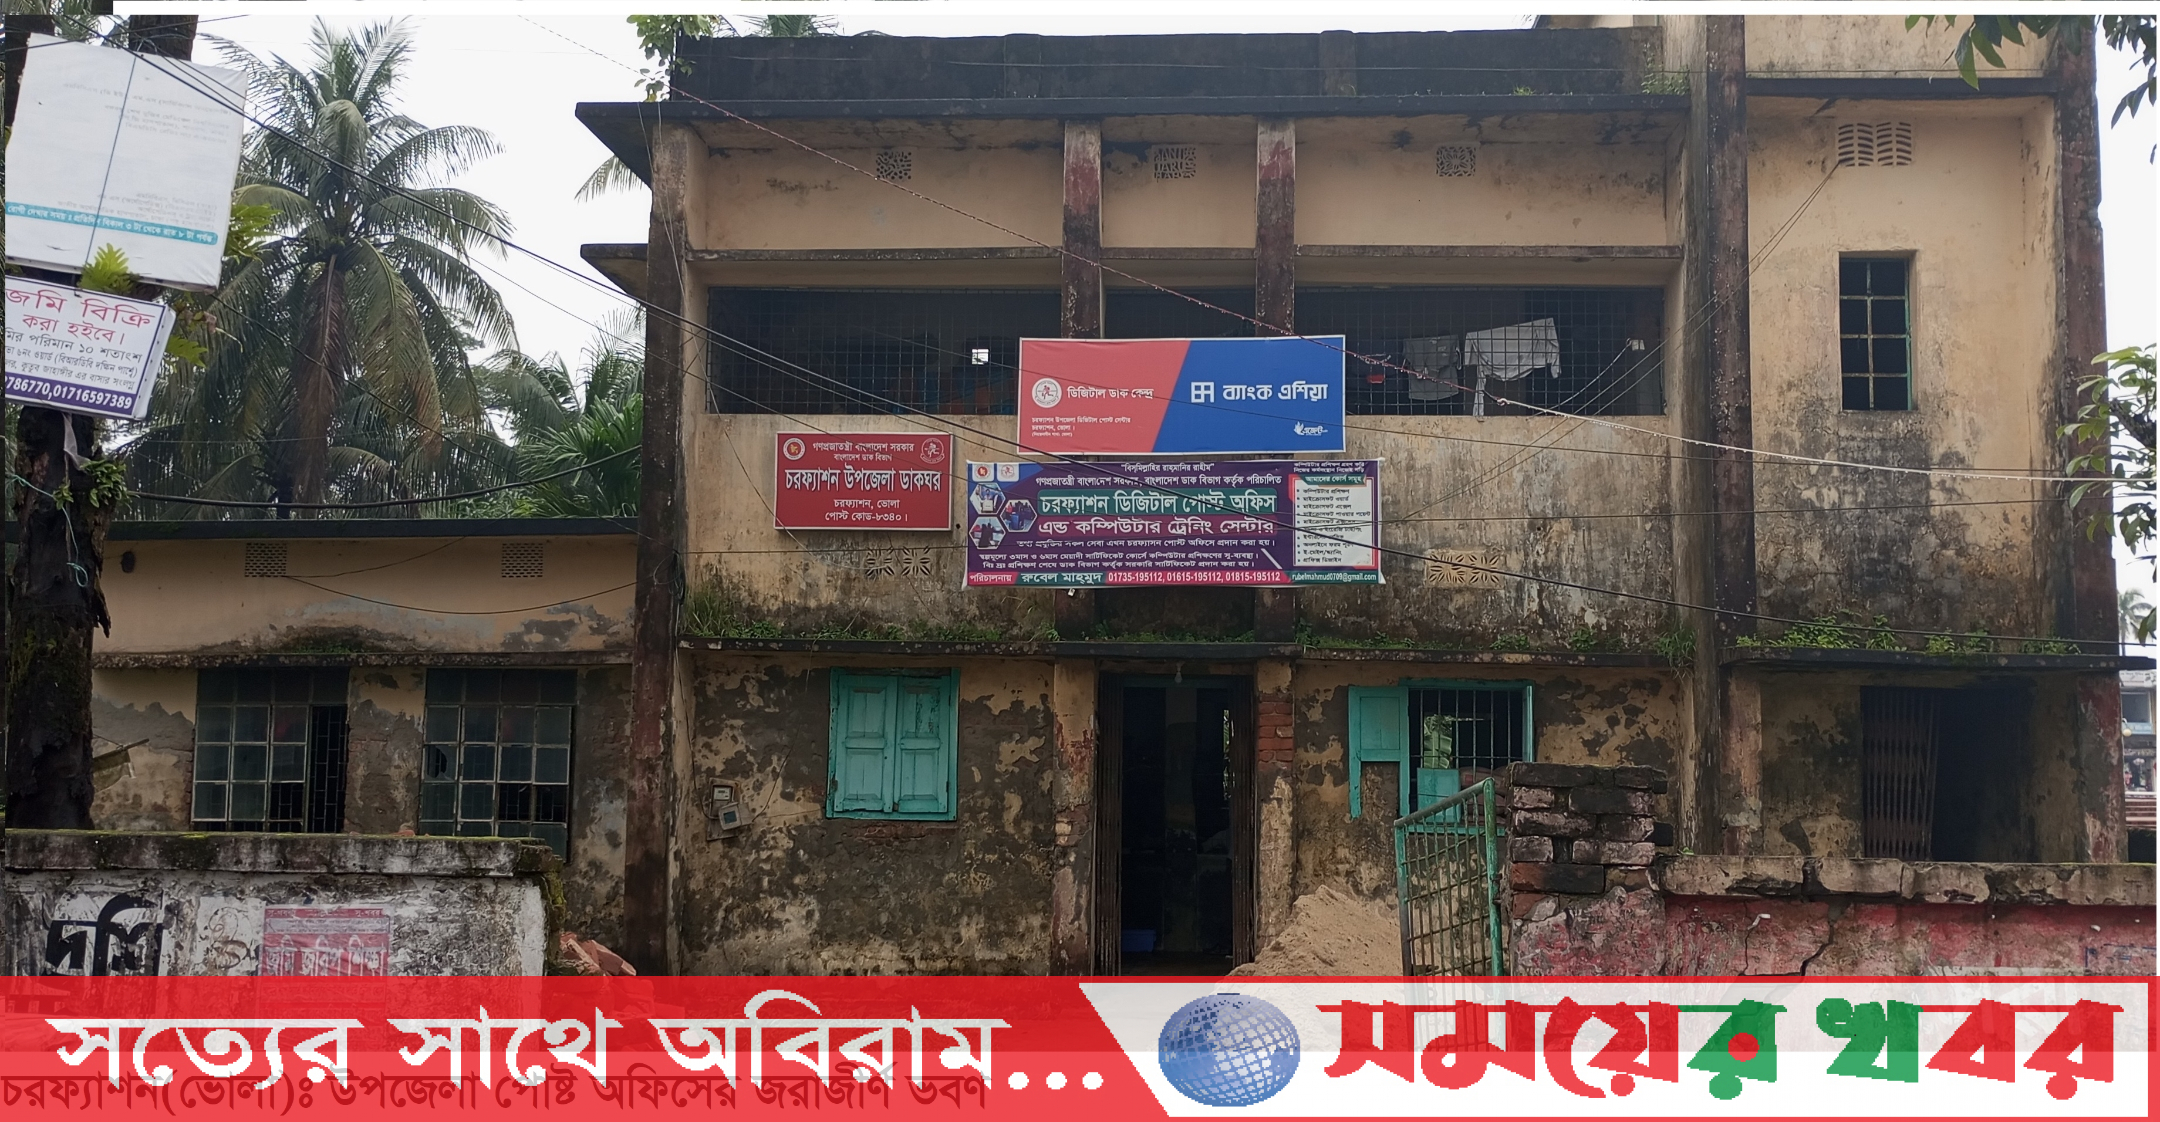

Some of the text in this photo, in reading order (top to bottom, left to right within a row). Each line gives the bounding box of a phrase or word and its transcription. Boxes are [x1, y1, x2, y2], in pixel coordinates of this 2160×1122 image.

[5, 288, 155, 328] জমি বিক্রি
[22, 313, 60, 333] করা
[5, 327, 24, 343] মির
[29, 333, 74, 351] পরিমান
[78, 343, 94, 354] ১০
[100, 347, 143, 364] শতাংশ
[74, 371, 87, 382] এর
[89, 373, 110, 386] বাসার
[1067, 385, 1154, 400] ডিজিটাল ডাক কেন্দ্র
[1222, 380, 1328, 402] ব্যাংক এশিয়া
[812, 441, 853, 453] গণপ্রজাতন্ত্রী
[855, 442, 888, 453] বাংলাদেশ
[890, 442, 915, 453] সরকার
[833, 453, 893, 462] বাংলাদেশ ডাক বিভাগ
[785, 462, 943, 493] চরফ্যাশন উপজেলা ডাকঘর
[1077, 476, 1111, 487] বাংলাদেশ
[1144, 475, 1179, 487] বাংলাদেশ
[1181, 475, 1197, 485] ডাক
[1199, 473, 1221, 485] বিভাগ
[1246, 473, 1282, 485] পরিচালিত
[876, 498, 900, 509] ভোলা
[1040, 488, 1277, 514] চরফ্যাশন ডিজিটাল পোস্ট অফিস
[824, 509, 850, 522] পোস্ট
[1039, 515, 1274, 536] এন্ড কম্পিউটার ট্রেনিং সেন্টার
[1164, 538, 1186, 547] পোস্ট
[1188, 537, 1215, 547] অফিসে
[1217, 539, 1239, 547] প্রদান
[1240, 539, 1256, 547] করা
[1149, 551, 1186, 560] কম্পিউটার
[1077, 560, 1100, 568] বিভাগ
[1125, 560, 1153, 568] সরকারি
[970, 572, 1058, 583] পরিচালনায় রুবেল
[1108, 571, 1280, 583] 01735-195112, 01615-195112, 01815-195112
